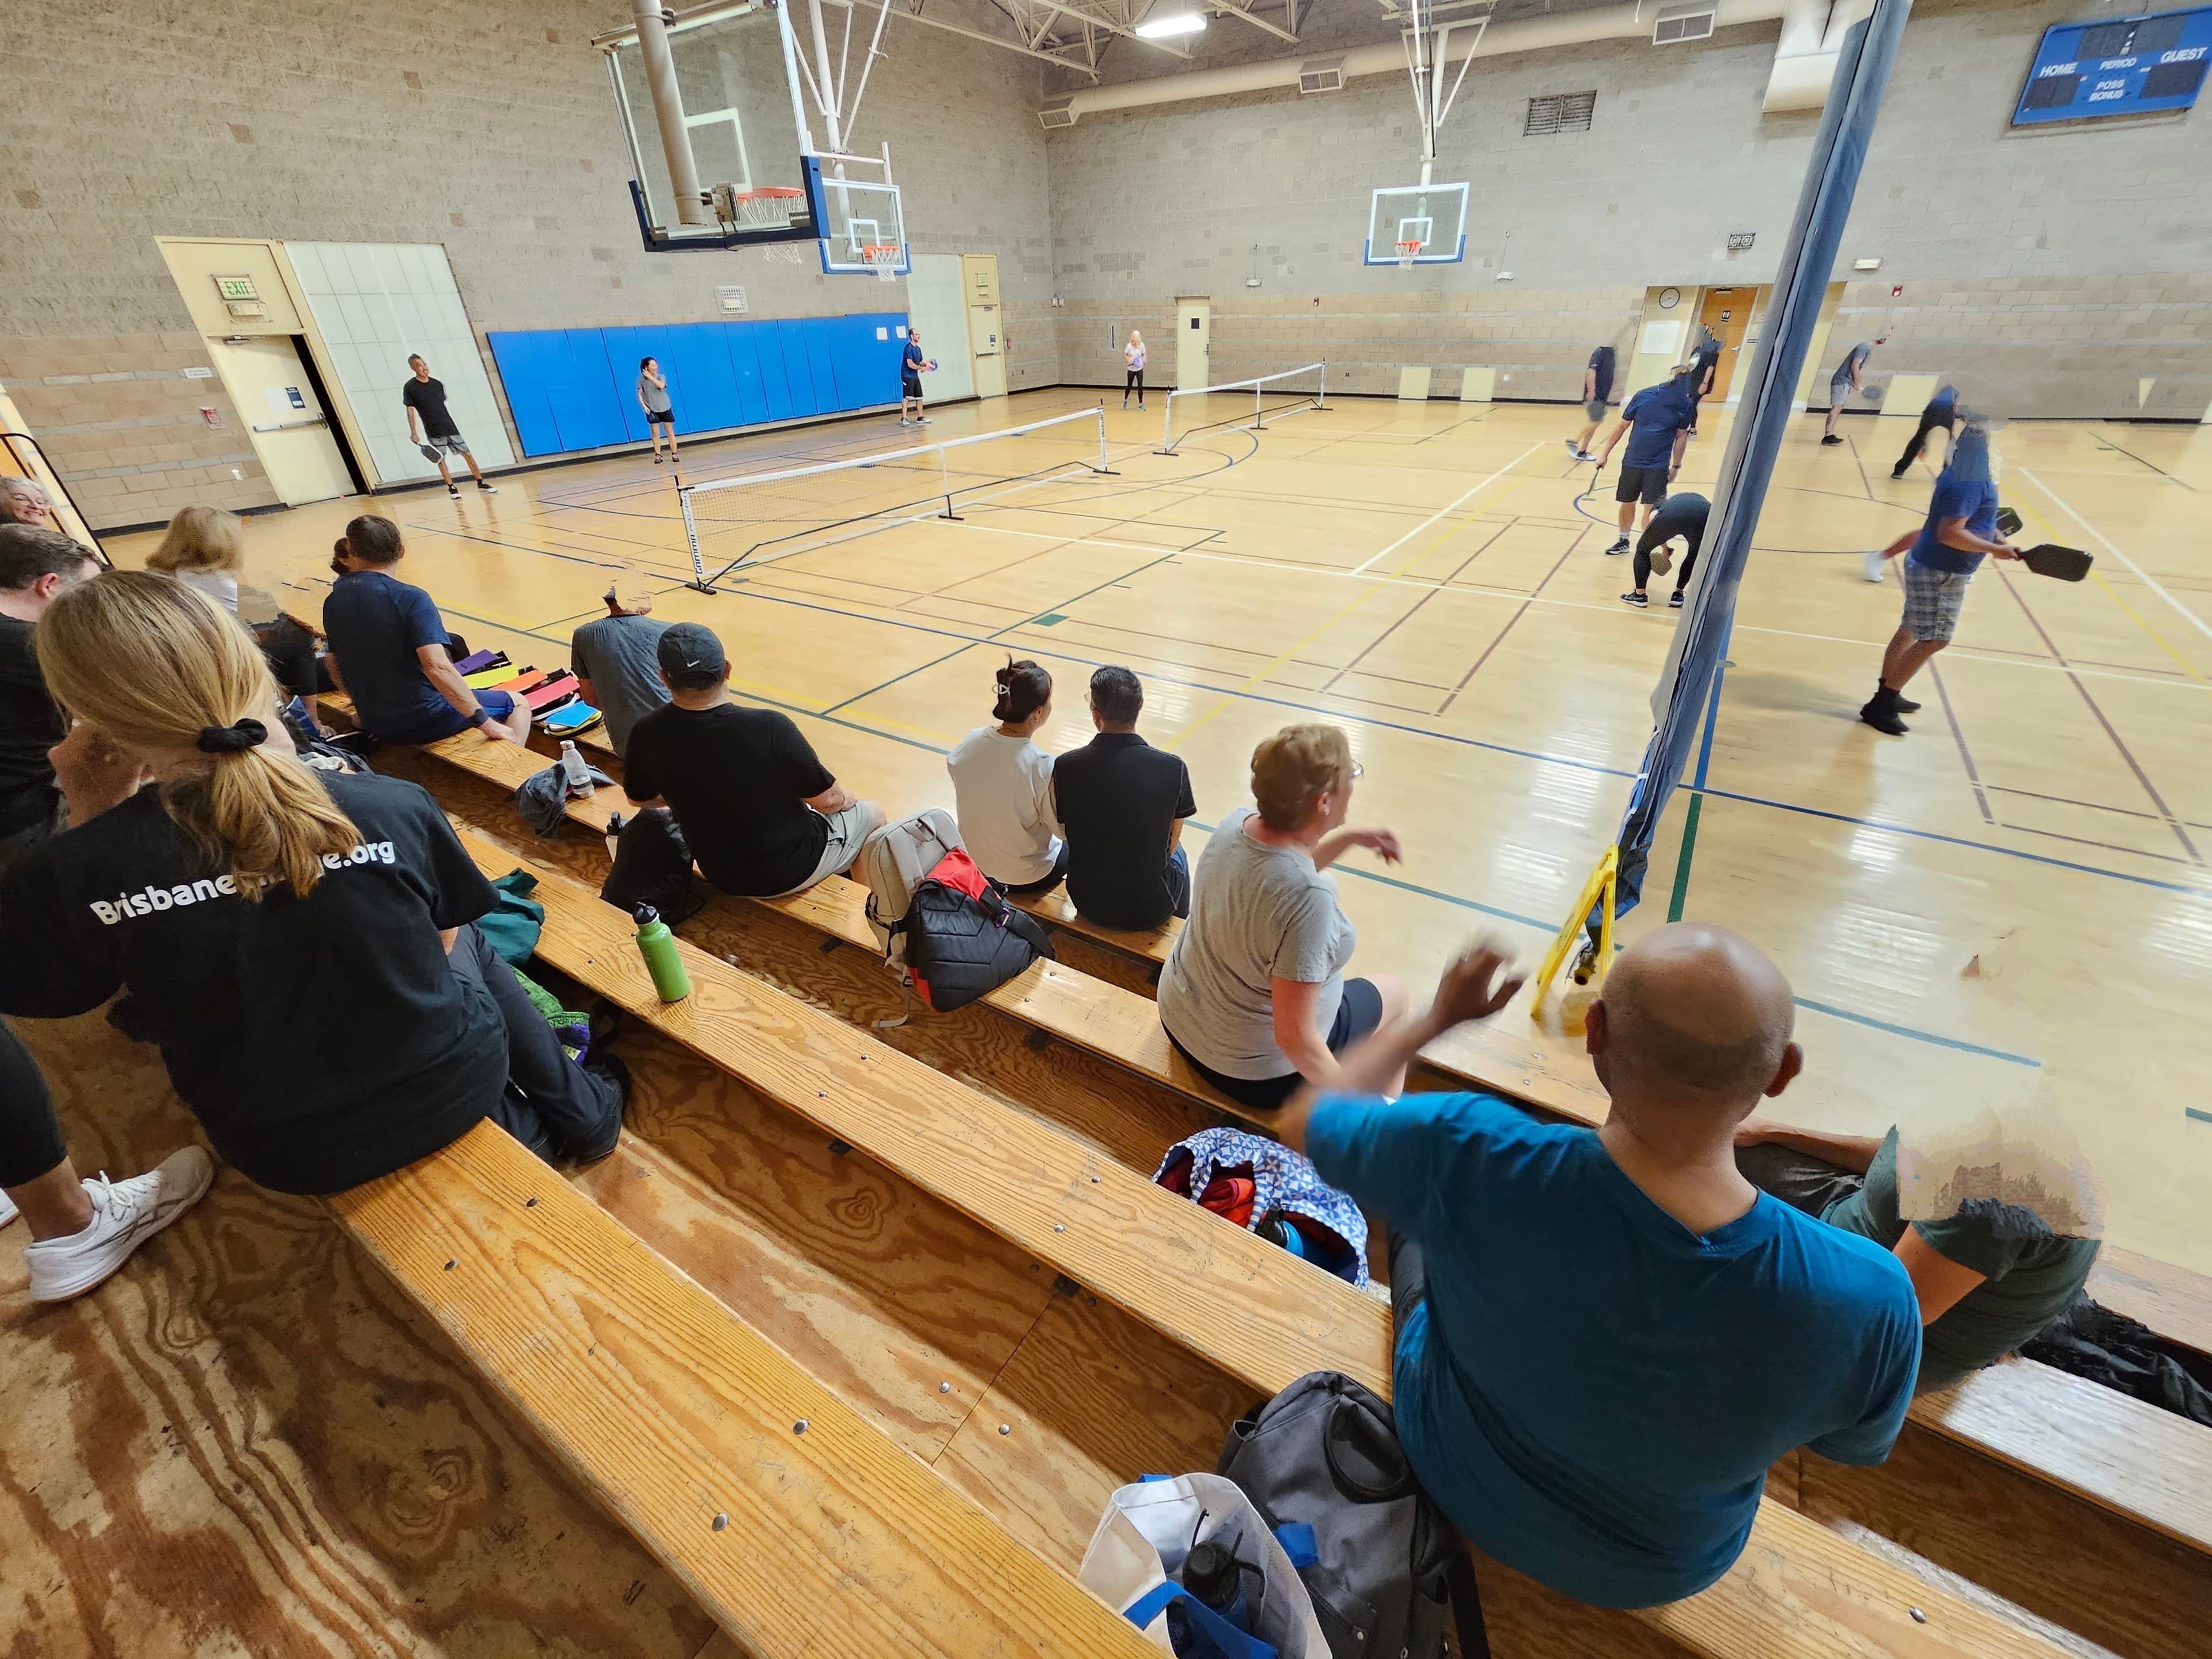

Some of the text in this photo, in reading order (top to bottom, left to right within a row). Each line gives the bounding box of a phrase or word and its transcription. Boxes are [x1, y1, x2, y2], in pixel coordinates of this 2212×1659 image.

[2161, 46, 2207, 63] GUEST
[2040, 61, 2078, 77] HOME
[2096, 79, 2126, 90] POSS
[2088, 89, 2124, 102] BONUS
[224, 281, 249, 296] EXIT
